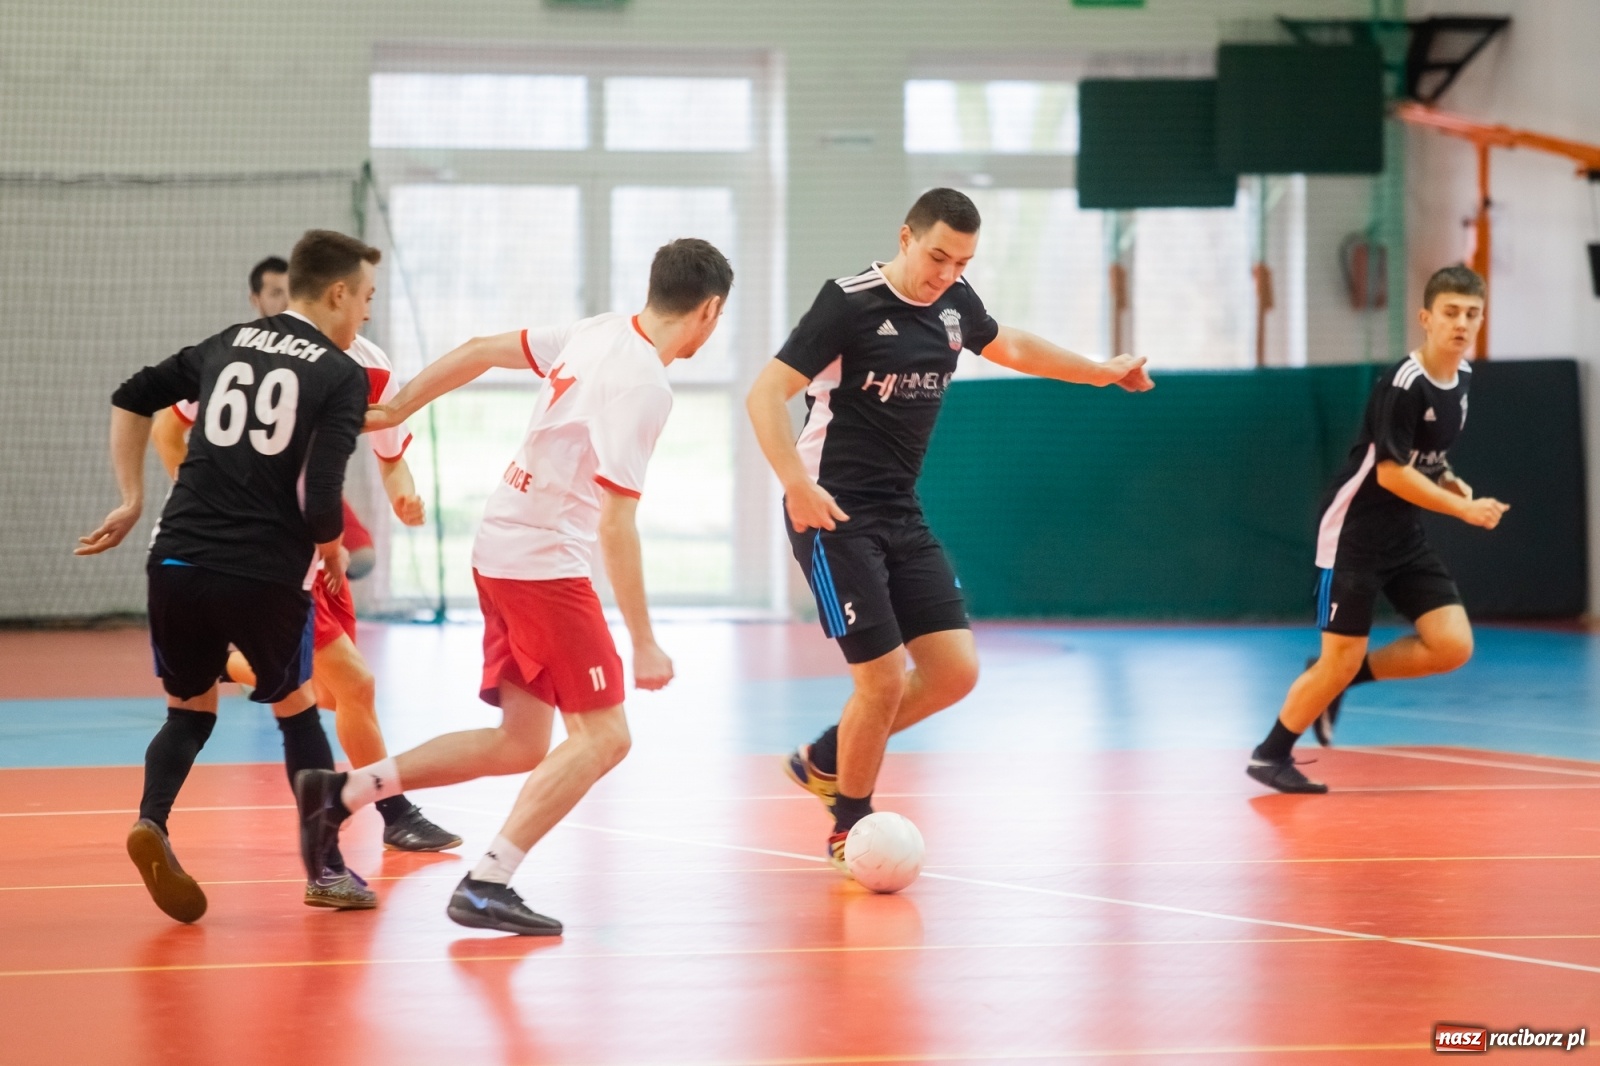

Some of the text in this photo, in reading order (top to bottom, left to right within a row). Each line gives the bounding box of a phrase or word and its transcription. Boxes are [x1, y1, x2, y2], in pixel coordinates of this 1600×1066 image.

[231, 327, 328, 363] WALACH
[204, 361, 299, 456] 69
[844, 601, 857, 625] 5
[588, 665, 607, 692] 11
